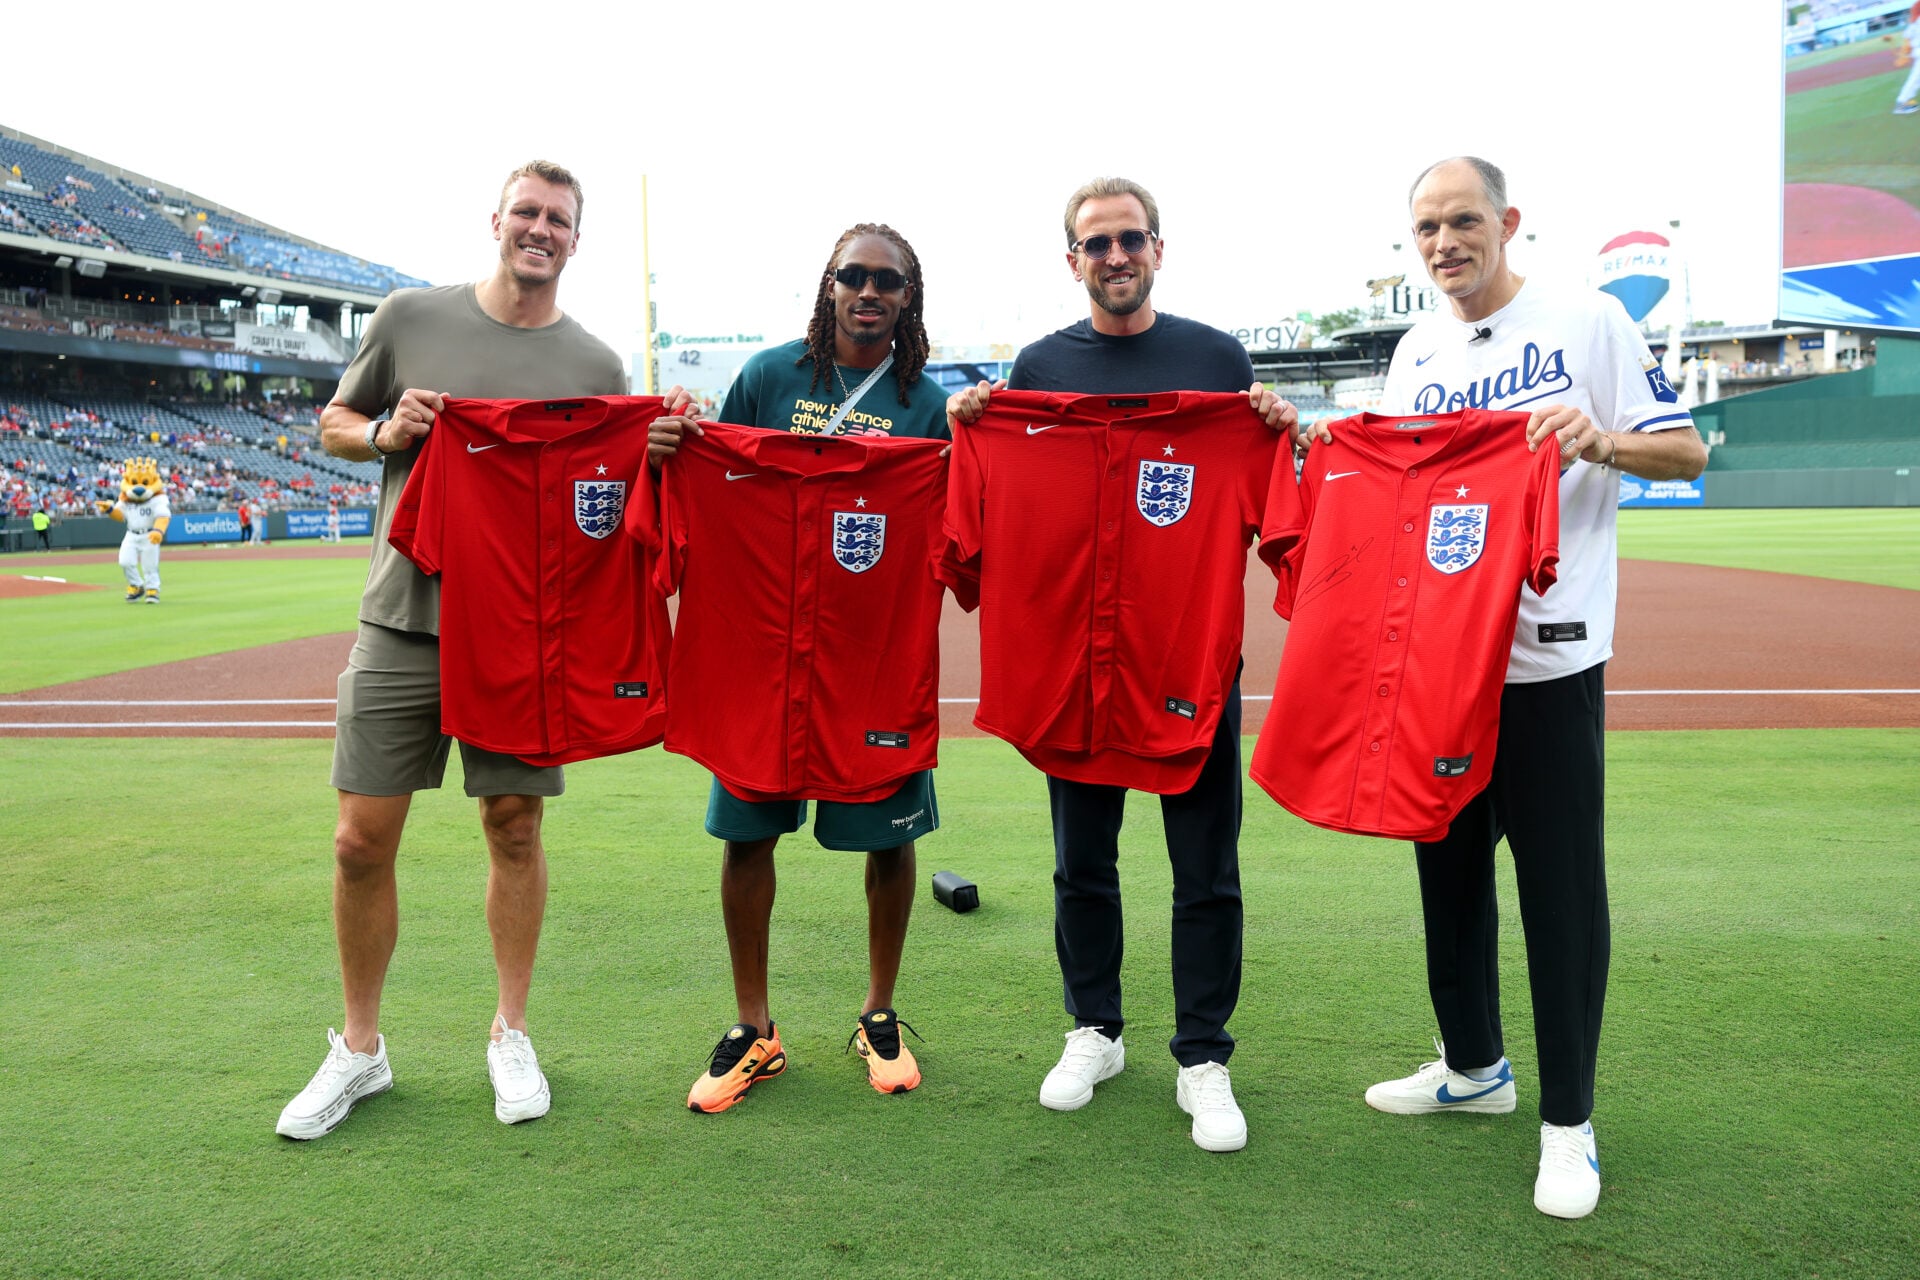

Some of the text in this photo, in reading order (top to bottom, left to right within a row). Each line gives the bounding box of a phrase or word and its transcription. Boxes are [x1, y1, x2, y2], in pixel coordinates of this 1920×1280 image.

[1604, 255, 1667, 272] RE/MAX
[675, 334, 763, 345] Commerce Bank
[214, 352, 248, 371] GAME
[679, 350, 701, 366] 42
[1415, 342, 1572, 414] Royals
[792, 412, 846, 435] athlec
[795, 399, 893, 430] new blance
[184, 517, 241, 534] benefitba
